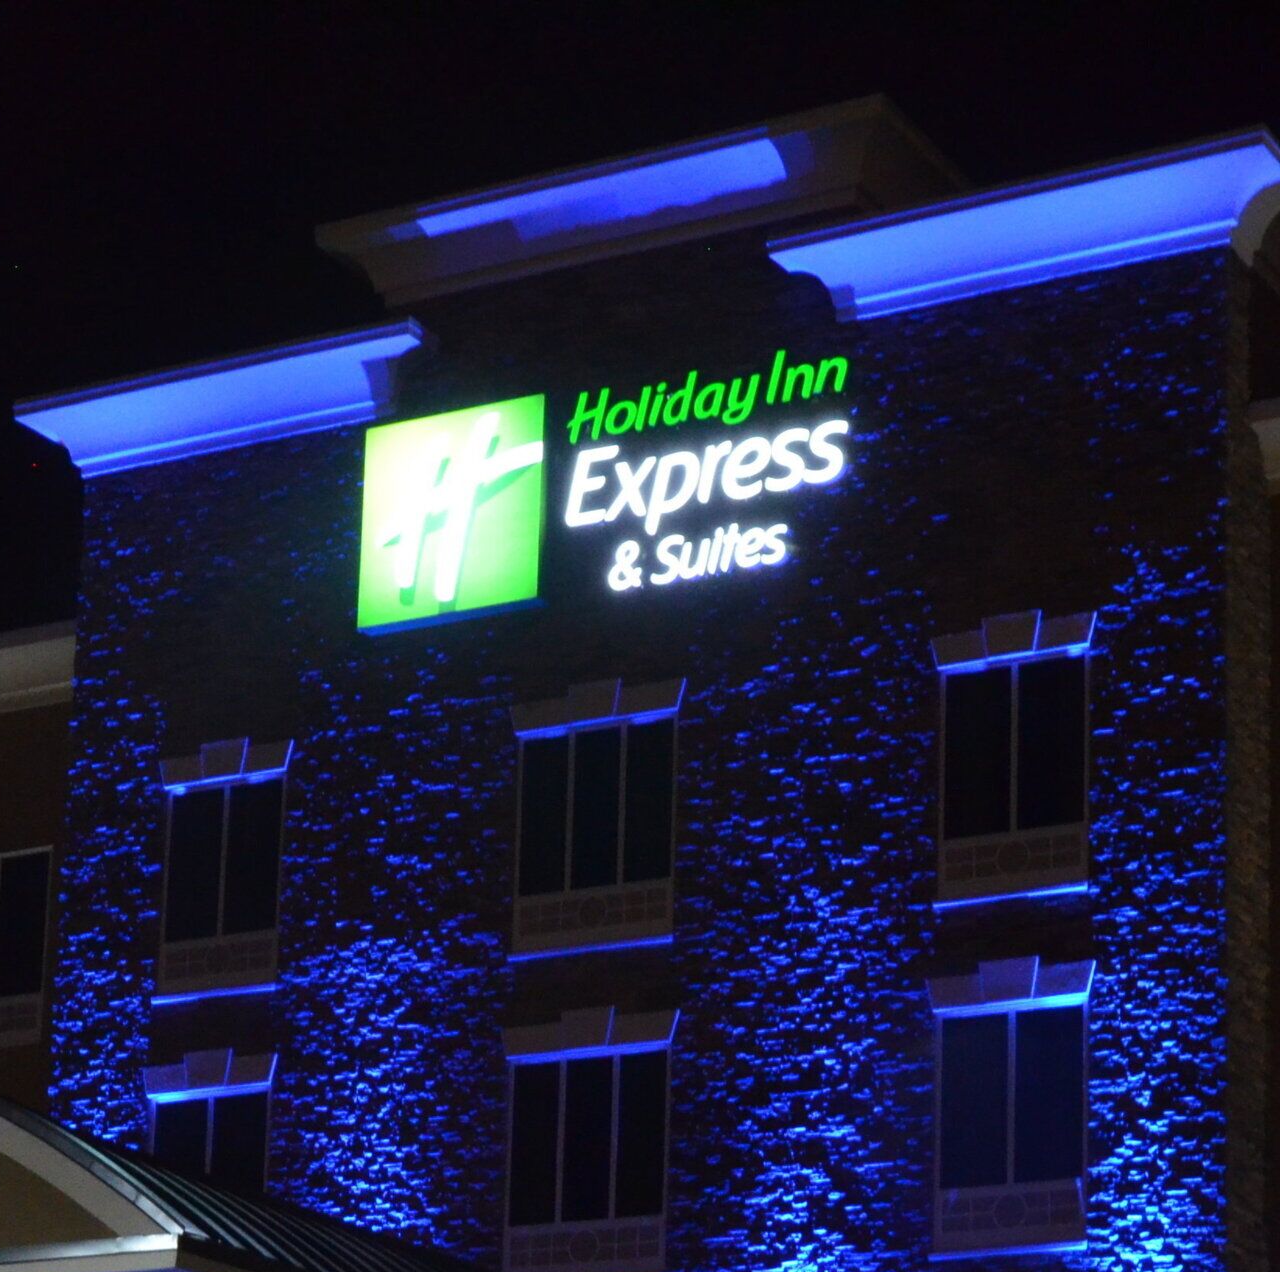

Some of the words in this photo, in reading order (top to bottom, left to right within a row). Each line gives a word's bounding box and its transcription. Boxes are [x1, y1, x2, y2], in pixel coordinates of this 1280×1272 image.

[566, 369, 761, 445] Holiday
[765, 349, 849, 405] Inn
[562, 418, 850, 537] Express
[605, 539, 644, 593] &
[649, 521, 790, 587] Suites
